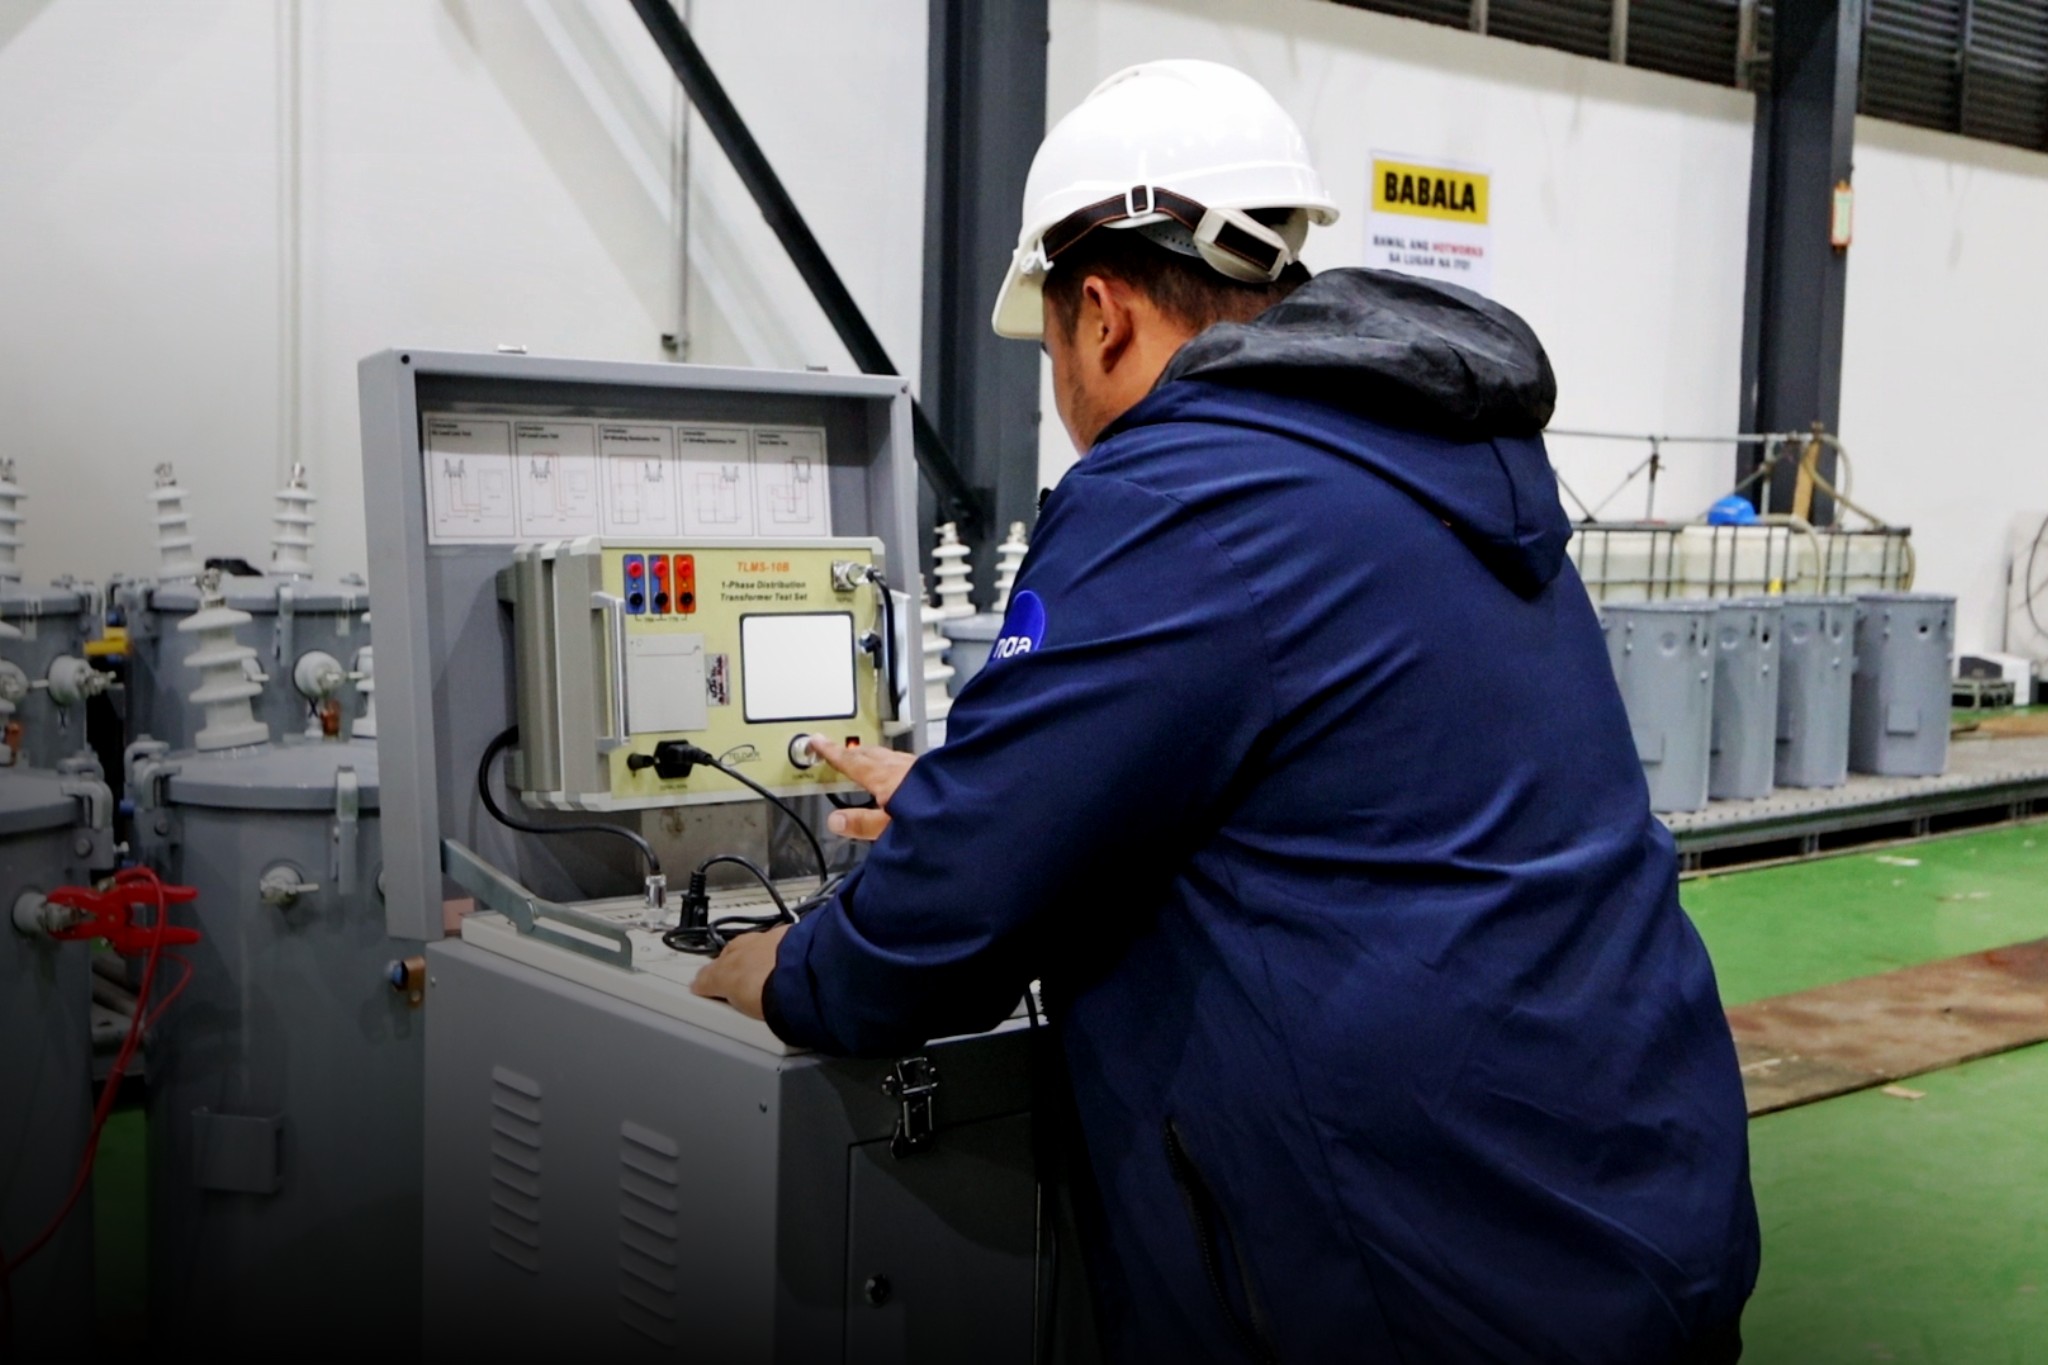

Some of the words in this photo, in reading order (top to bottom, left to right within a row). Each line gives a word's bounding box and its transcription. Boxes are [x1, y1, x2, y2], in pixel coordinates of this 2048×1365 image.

[1384, 171, 1475, 213] BABALA
[721, 580, 755, 589] 1-Phase
[757, 580, 806, 589] Distribution
[720, 592, 772, 601] Transformer
[775, 592, 792, 601] Test
[795, 592, 807, 601] Set
